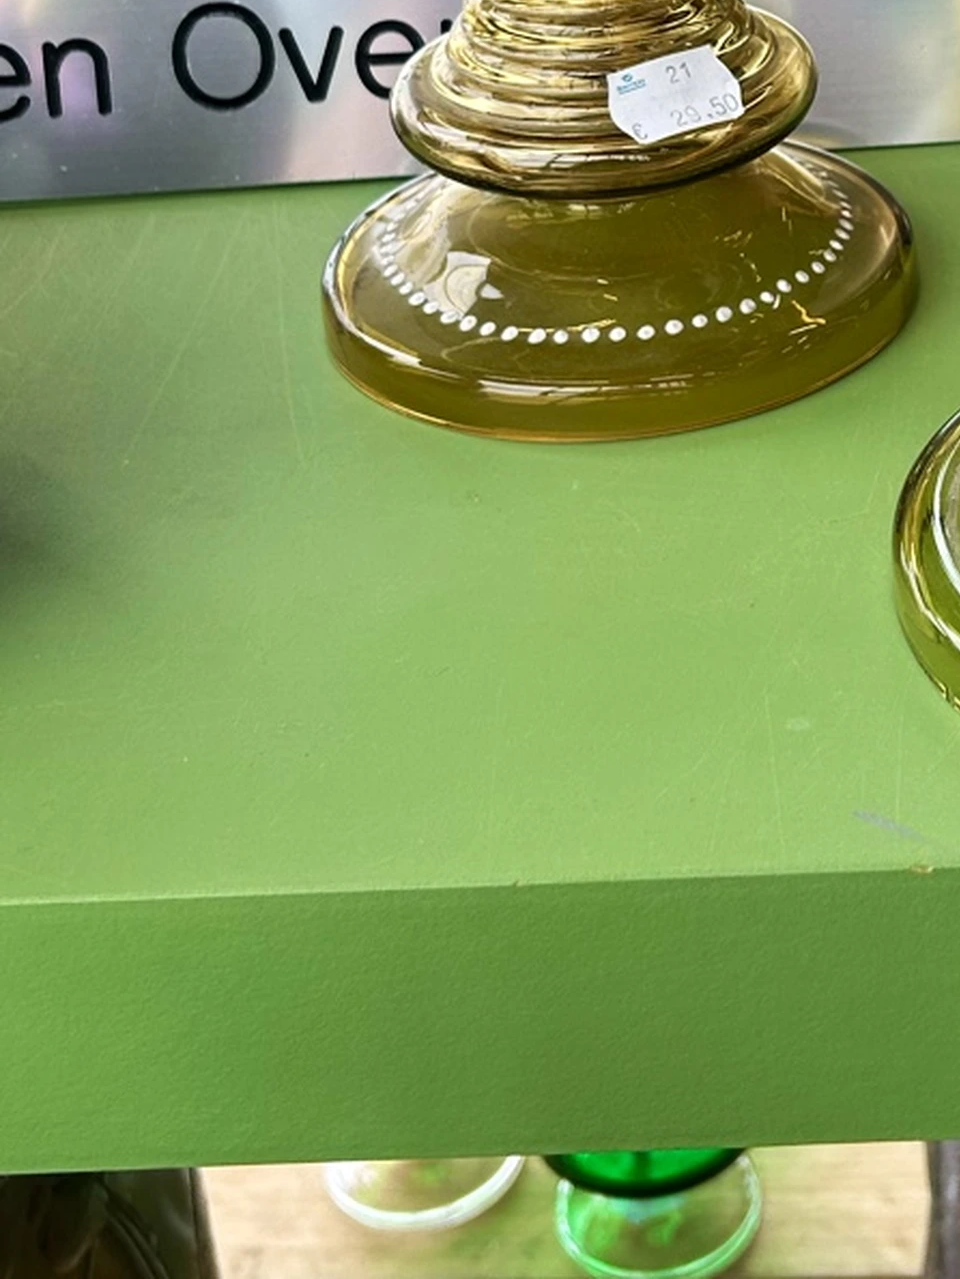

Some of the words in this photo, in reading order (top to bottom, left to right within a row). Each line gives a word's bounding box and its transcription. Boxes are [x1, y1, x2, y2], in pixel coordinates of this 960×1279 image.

[172, 1, 453, 111] Ove
[665, 61, 692, 84] 21
[632, 123, 648, 140] €
